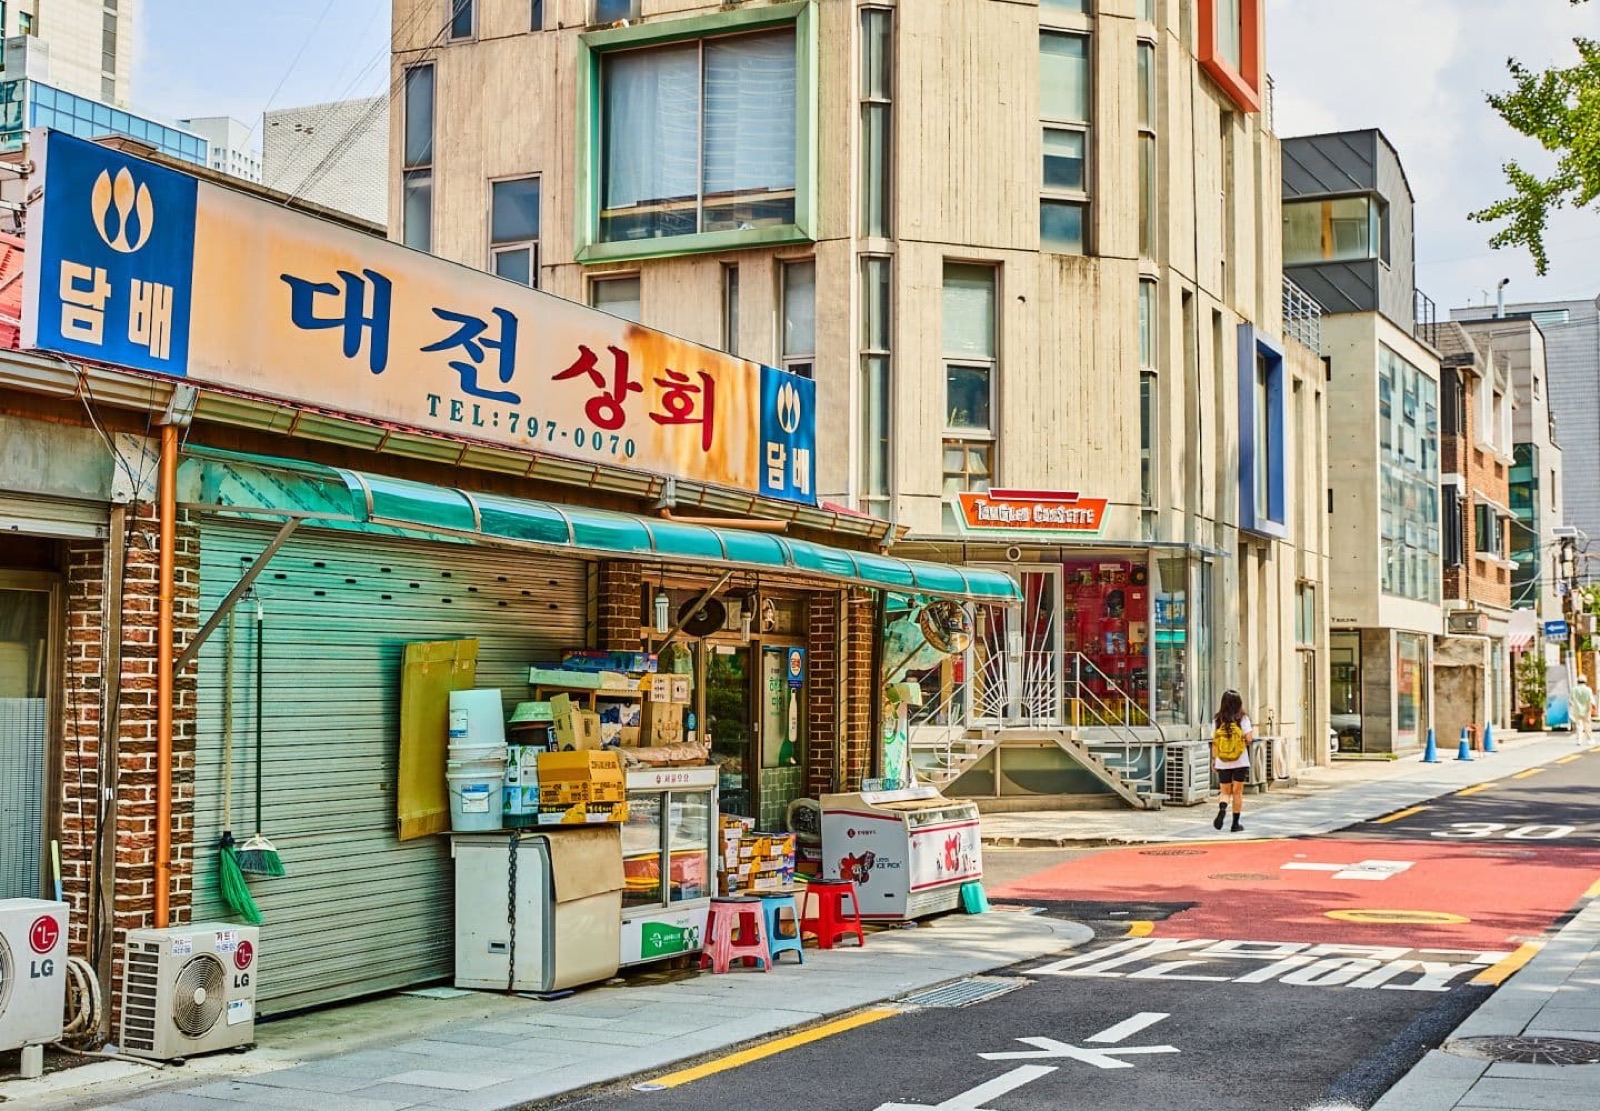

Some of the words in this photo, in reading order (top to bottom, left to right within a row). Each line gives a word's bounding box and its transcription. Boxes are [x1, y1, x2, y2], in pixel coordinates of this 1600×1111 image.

[59, 259, 174, 361] 담배
[280, 268, 522, 405] 대전
[550, 344, 716, 452] 상회
[426, 392, 637, 459] TEL:797-0070
[766, 441, 811, 495] 담배
[1430, 821, 1576, 840] 30
[30, 959, 54, 979] LG
[233, 973, 250, 988] LG
